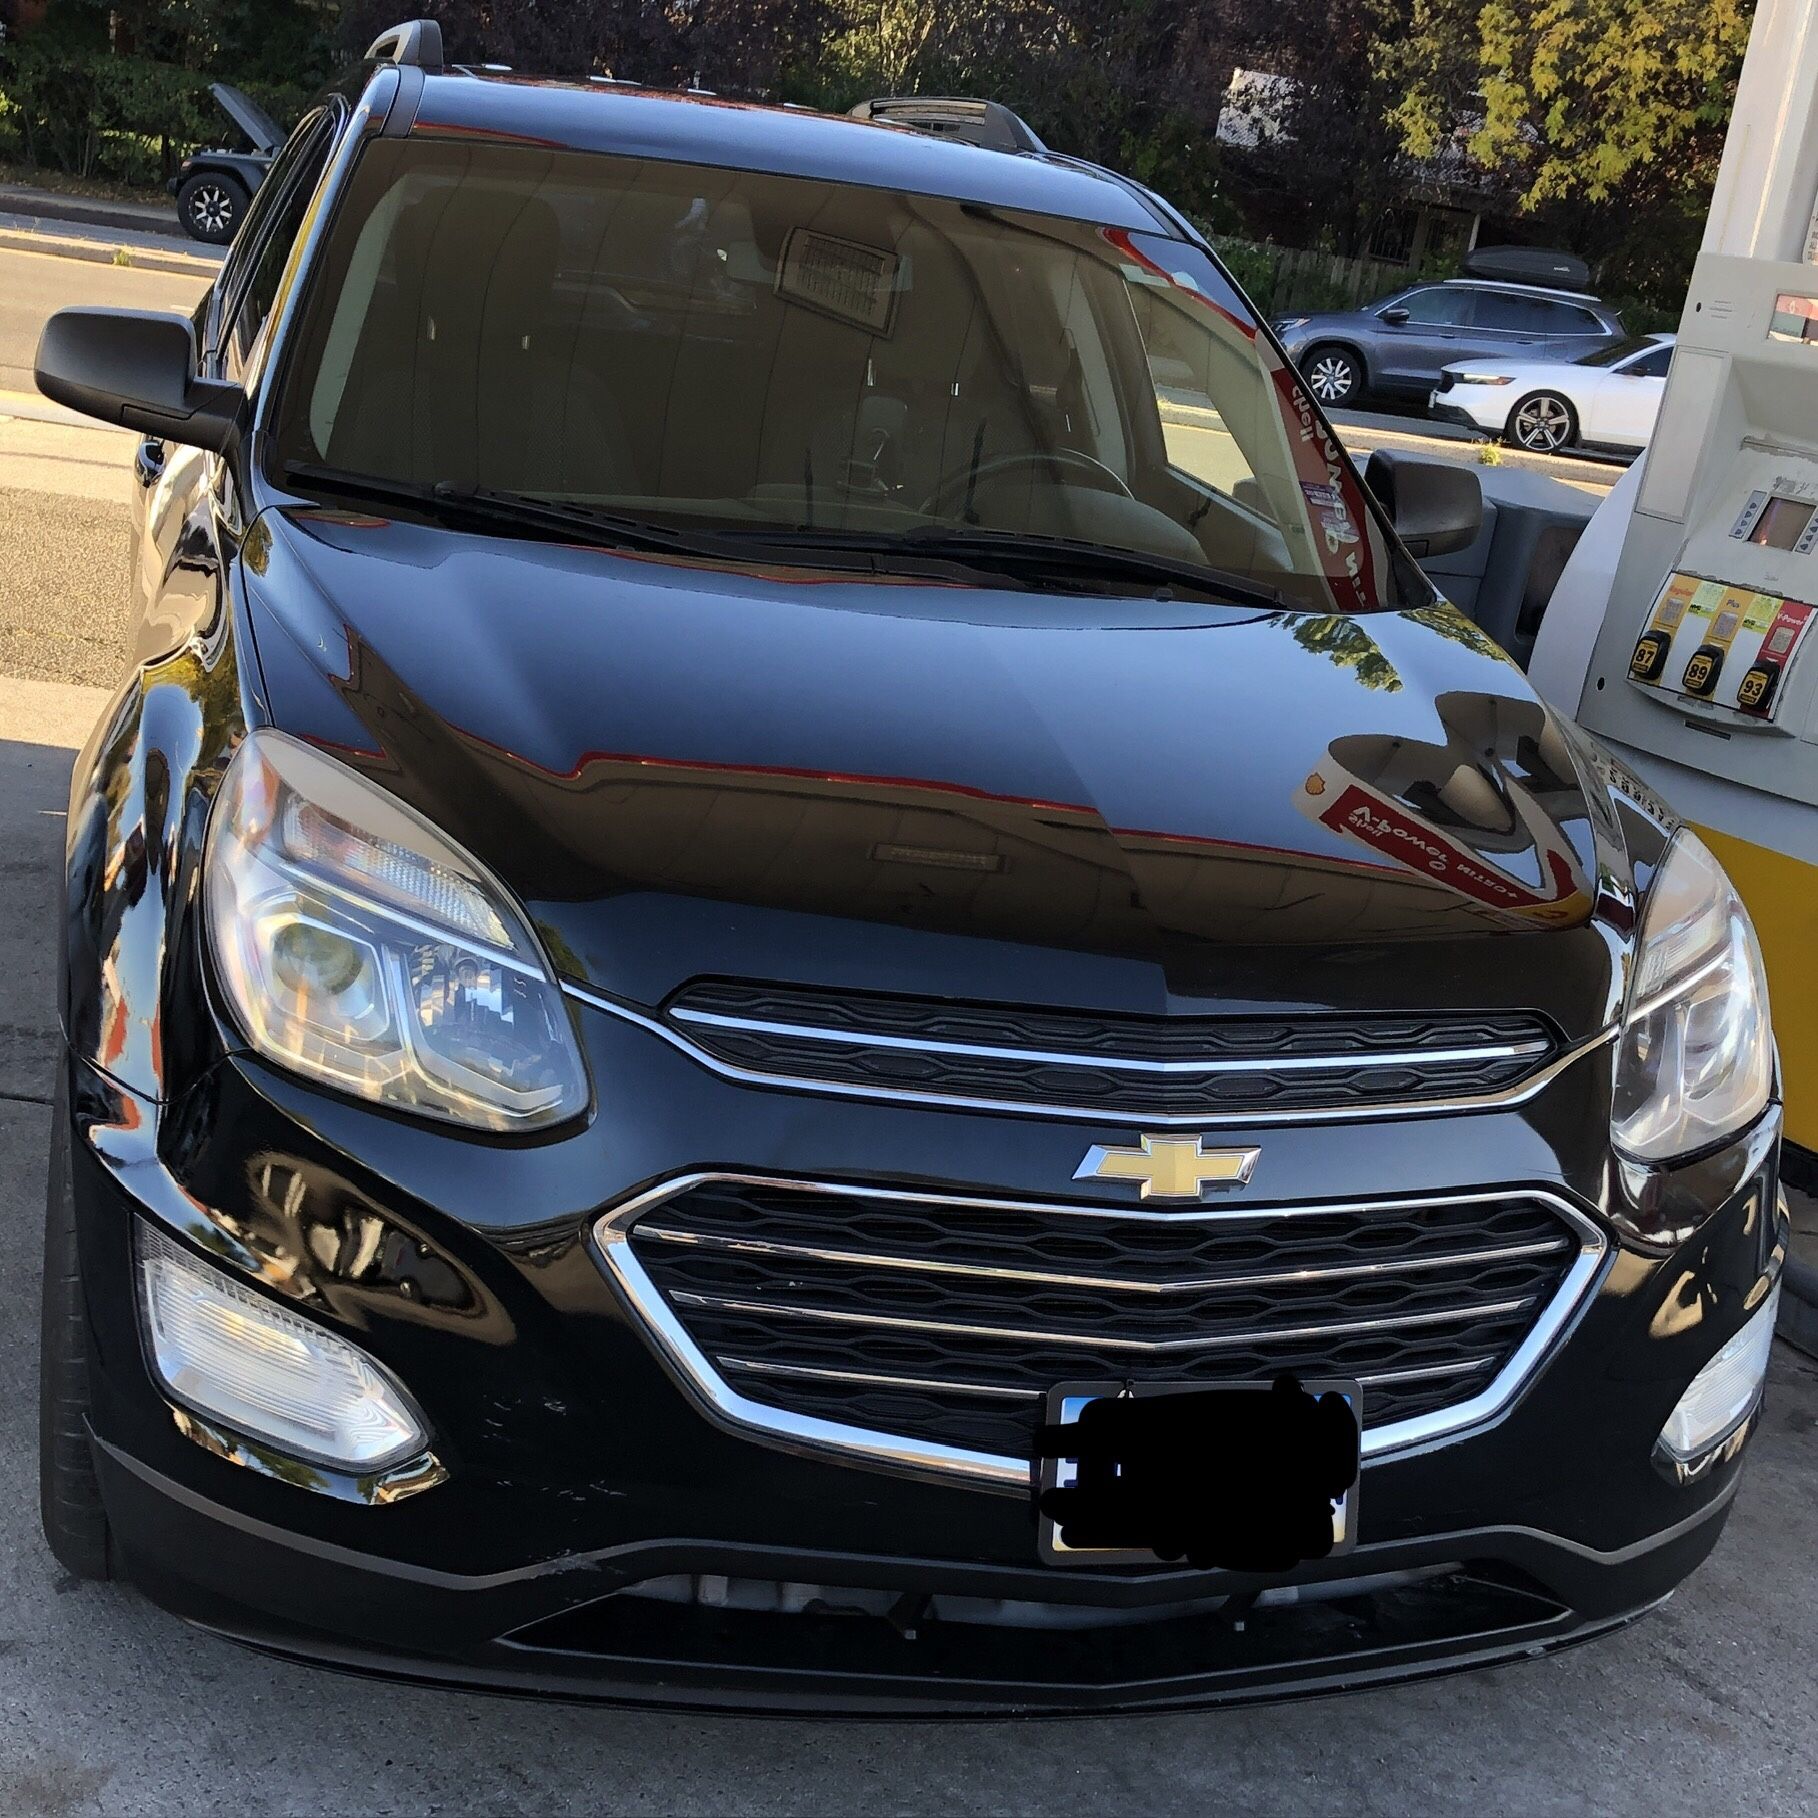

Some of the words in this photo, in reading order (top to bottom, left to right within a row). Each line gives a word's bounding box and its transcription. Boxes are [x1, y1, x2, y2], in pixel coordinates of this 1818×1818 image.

[1726, 598, 1740, 609] Plus
[1635, 648, 1655, 664] 87
[1688, 663, 1708, 680] 89
[1743, 679, 1763, 696] 93
